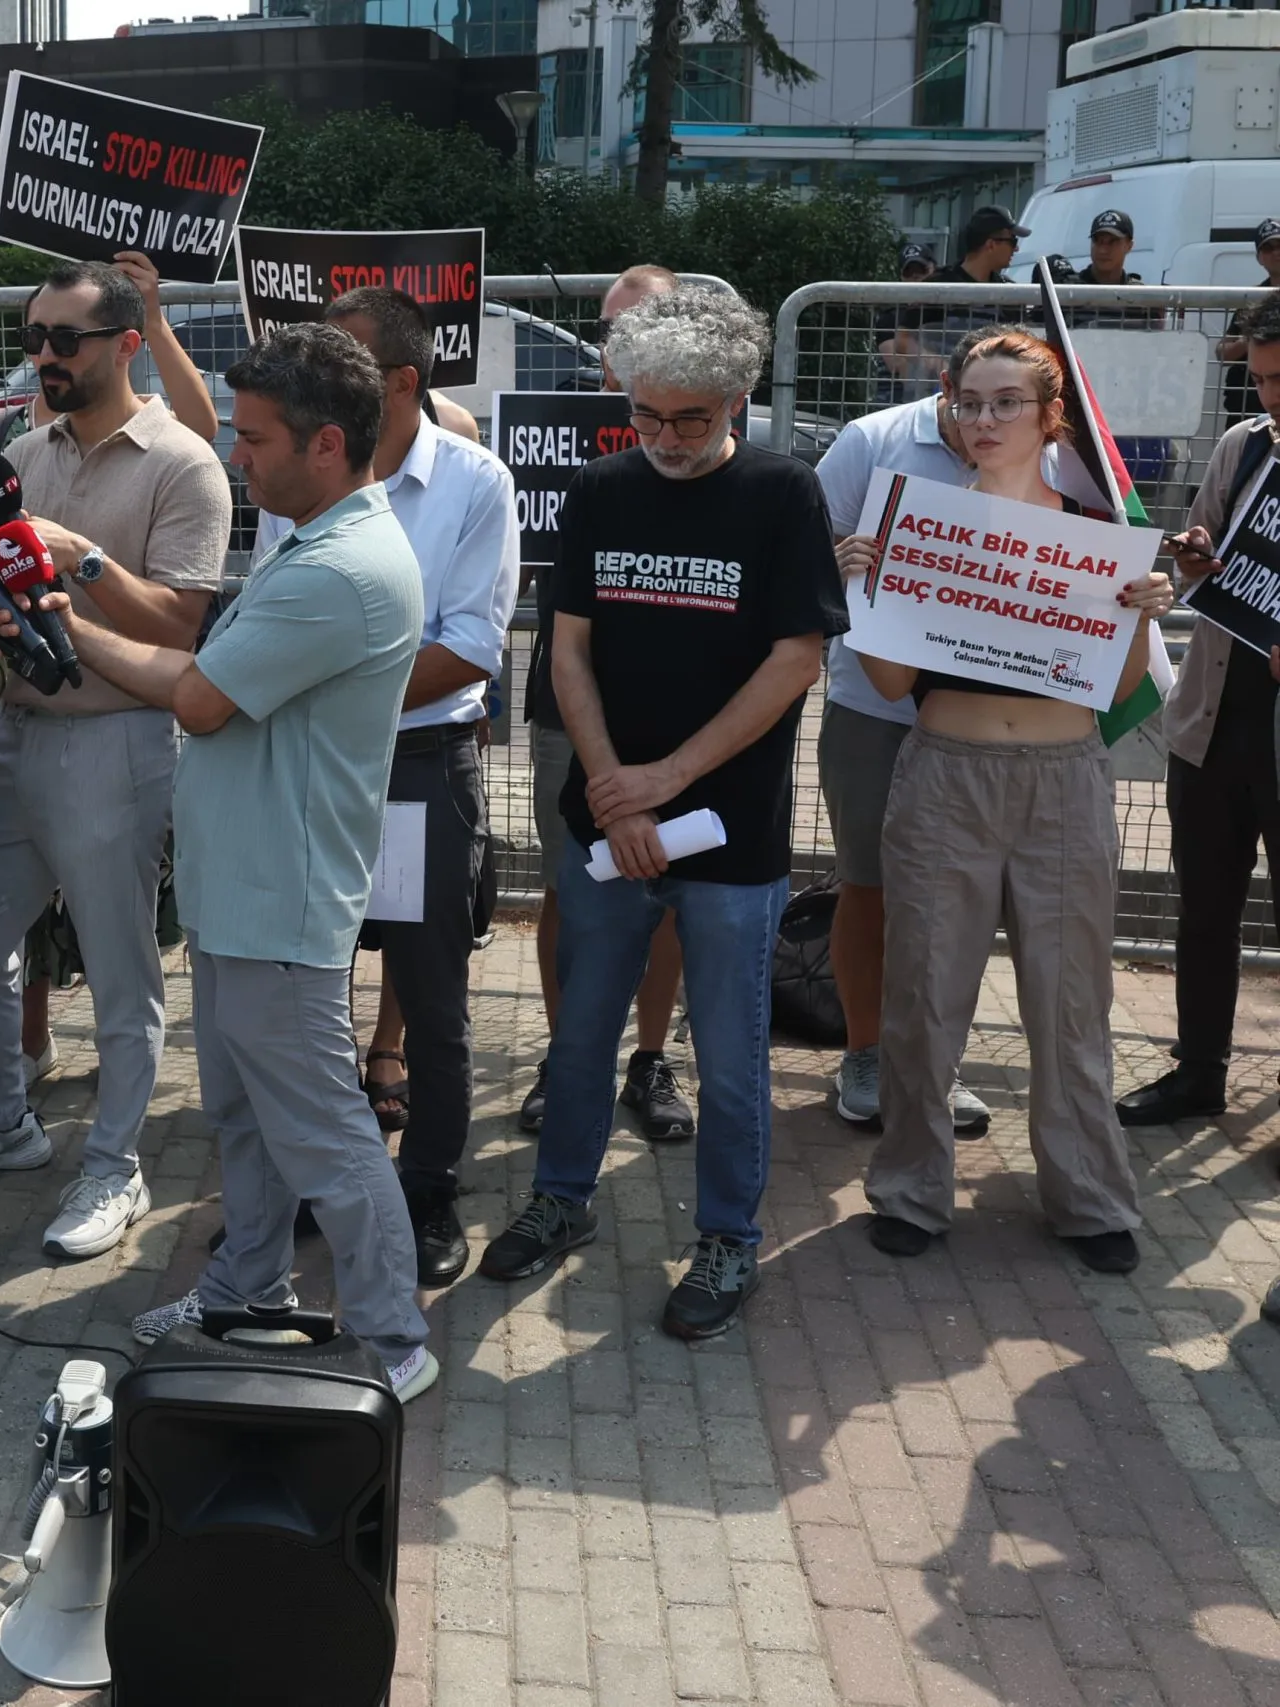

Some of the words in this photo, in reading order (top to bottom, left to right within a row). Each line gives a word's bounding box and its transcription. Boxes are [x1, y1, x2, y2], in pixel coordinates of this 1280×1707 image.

[19, 109, 98, 168] ISRAEL:
[102, 131, 162, 180] STOP
[163, 145, 247, 197] KILLING
[6, 172, 143, 246] JOURNALISTS
[144, 208, 172, 251] IN
[172, 215, 226, 257] GAZA
[251, 258, 324, 305] ISRAEL:
[393, 261, 475, 305] KILLING
[433, 323, 471, 362] AZA
[508, 425, 588, 467] ISRAEL:
[896, 513, 978, 547] AÇLIK
[981, 531, 1029, 559] BİR
[1034, 543, 1118, 578] SİLAH
[0, 556, 35, 577] anka
[595, 551, 742, 583] REPORTERS
[595, 573, 627, 587] SANS
[631, 575, 740, 599] FRONTIERES
[889, 543, 1020, 589] SESSİZLİK
[1027, 570, 1070, 599] İSE
[657, 595, 669, 603] DE
[881, 573, 933, 604] SUÇ
[936, 585, 1117, 641] ORTAKLIĞIDIR!
[925, 631, 957, 647] Türkiye
[959, 639, 985, 653] Basın
[987, 645, 1010, 658] Yayın
[1013, 651, 1049, 667] Matbaa
[953, 650, 1001, 668] Çalışanları
[1002, 662, 1045, 679] Sendikası
